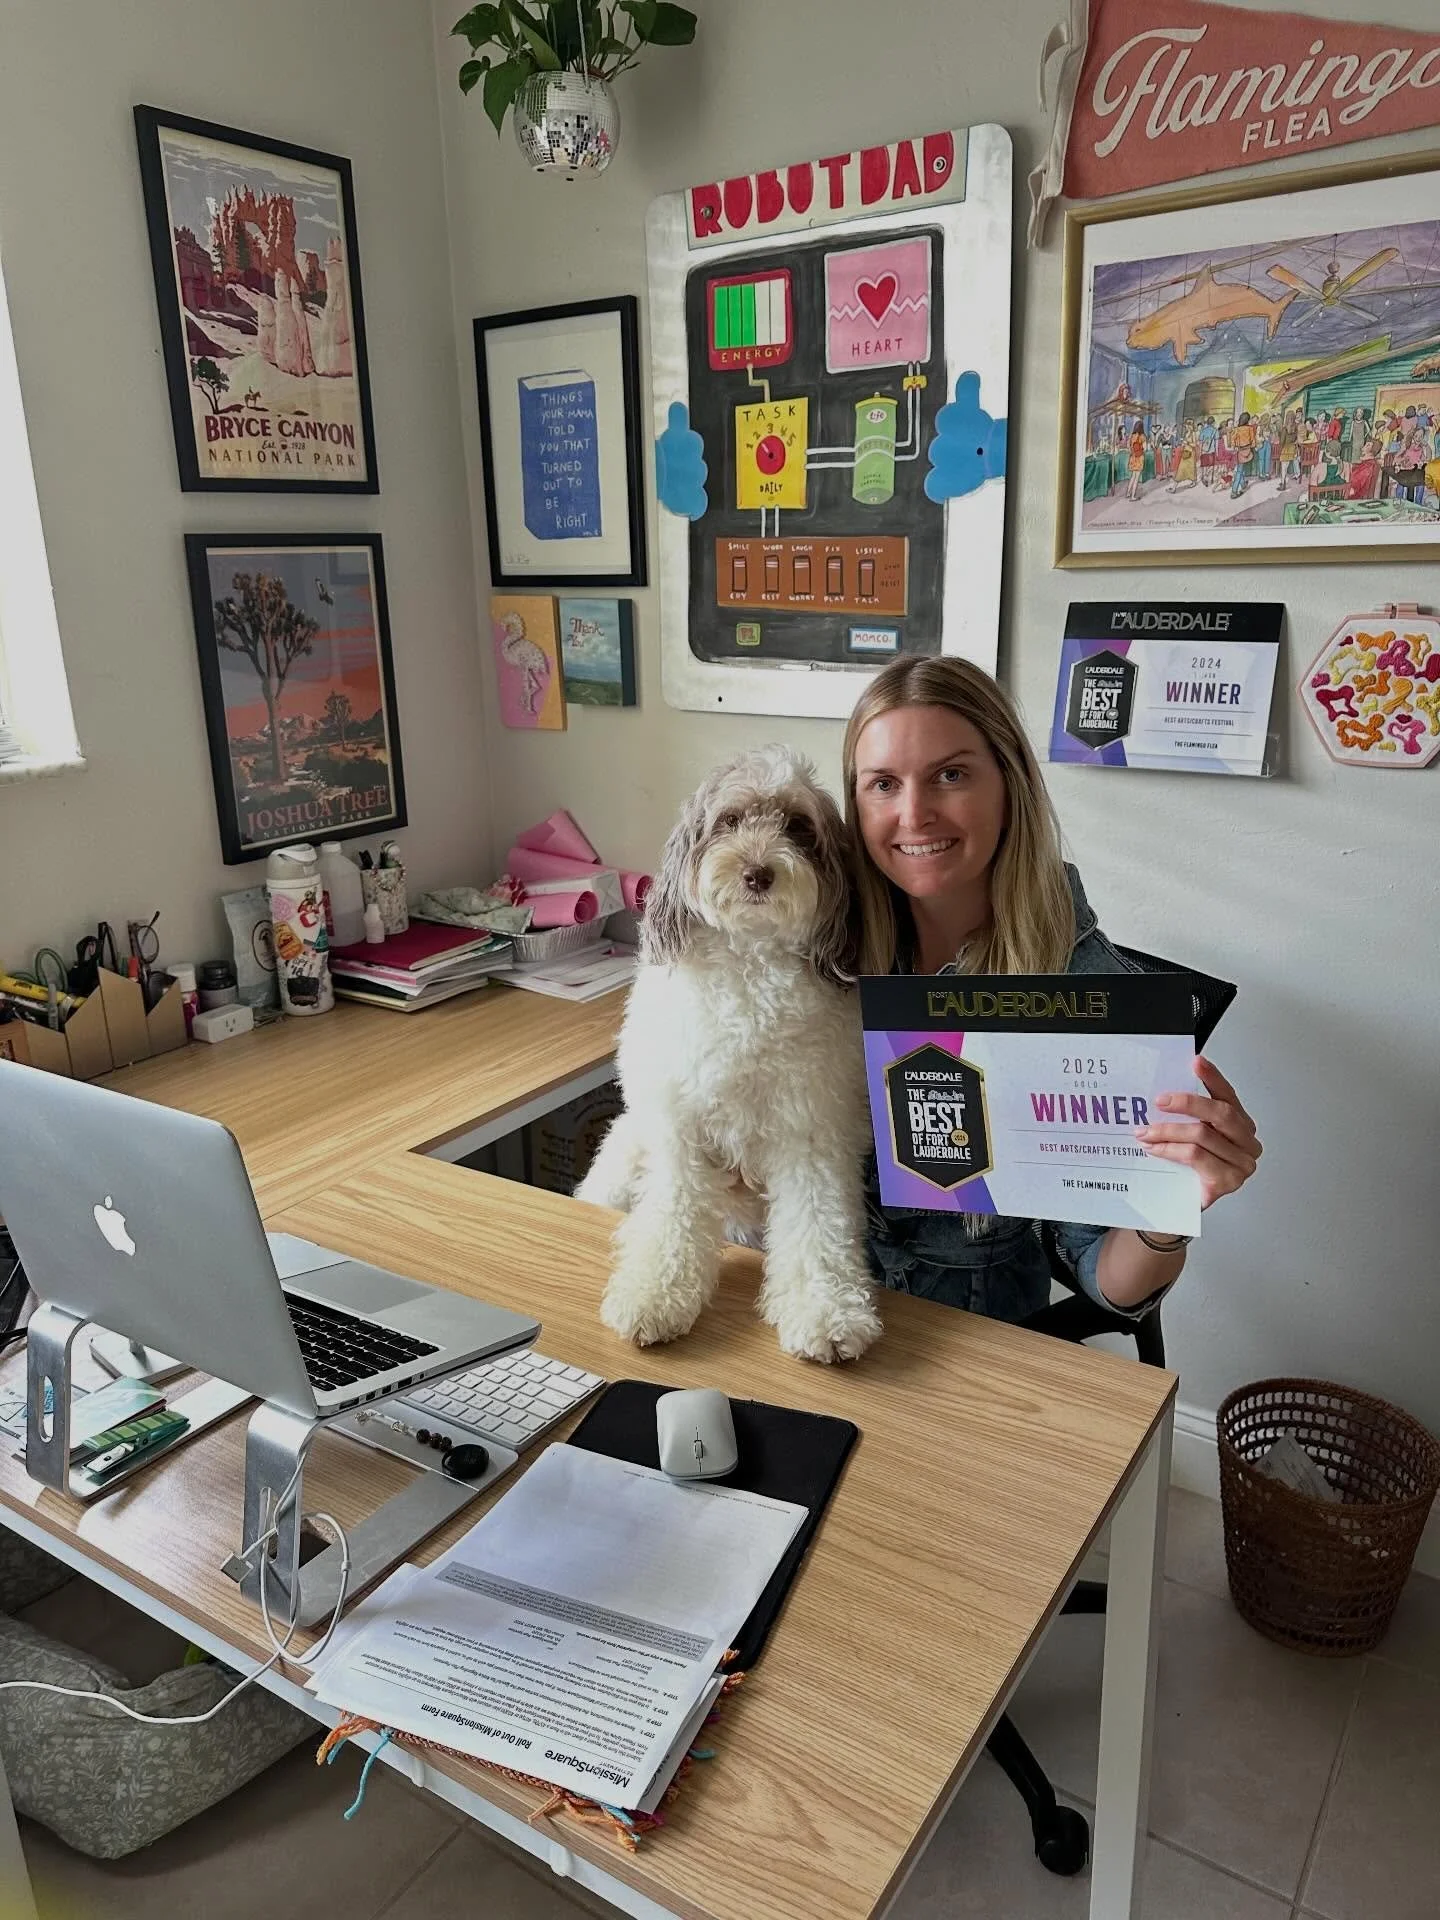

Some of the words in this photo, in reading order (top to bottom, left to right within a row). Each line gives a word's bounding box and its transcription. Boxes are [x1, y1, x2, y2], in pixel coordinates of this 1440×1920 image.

[1092, 24, 1440, 158] Flamingo
[1242, 108, 1332, 153] FLEA
[851, 337, 904, 357] HEART
[721, 347, 782, 363] ENERGY
[541, 391, 583, 406] THINGS
[567, 409, 594, 420] MAMA
[742, 404, 796, 422] TASK
[205, 415, 272, 443] BRYCE
[278, 419, 355, 449] CANYON
[549, 424, 575, 436] TOLD
[767, 423, 774, 434] 3
[780, 426, 788, 437] 4
[787, 432, 797, 447] 5
[564, 438, 591, 451] THAT
[208, 449, 303, 465] NATIONAL
[314, 453, 356, 467] PARK
[542, 460, 582, 474] TURNED
[543, 477, 562, 491] OUT
[567, 476, 582, 488] TO
[759, 481, 784, 495] DAILY
[545, 496, 559, 510] BE
[555, 513, 587, 530] RIGHT
[728, 542, 750, 551] SMILE
[855, 547, 884, 555] LISTEN
[823, 595, 845, 603] PLAY
[569, 616, 605, 637] Thank
[1110, 612, 1229, 631] LAUDERDALE
[1084, 666, 1125, 675] LAUDERDALE
[1191, 657, 1221, 669] 2024
[1083, 678, 1097, 688] THE
[1080, 687, 1122, 711] BEST
[1166, 681, 1241, 705] WINNER
[1079, 710, 1089, 719] OF
[1089, 710, 1106, 720] FORT
[1164, 716, 1177, 724] BEST
[1177, 717, 1211, 726] ARTS/CRAFTS
[1078, 719, 1119, 730] LAUDERDALE
[1174, 740, 1183, 748] THE
[1183, 741, 1207, 749] FLAMINGO
[246, 800, 332, 839] JOSHUA
[334, 787, 389, 814] TREE
[263, 818, 333, 840] NATIONAL
[341, 811, 371, 825] PARK
[926, 990, 1105, 1018] LAUDERDALE
[1062, 1058, 1108, 1075] 2025
[904, 1071, 963, 1082] LAUDERDALE
[906, 1088, 927, 1101] THE
[1030, 1092, 1150, 1126] WINNER
[907, 1101, 966, 1134] BEST
[911, 1132, 924, 1145] OF
[925, 1133, 950, 1147] FORT
[912, 1144, 972, 1160] LAUDERDALE
[1039, 1143, 1058, 1153] BEST
[1060, 1144, 1111, 1156] ARTS/CRAFTS
[1062, 1178, 1075, 1188] THE
[1076, 1180, 1111, 1191] FLAMINGO
[1112, 1182, 1129, 1192] FLEA
[420, 1702, 440, 1719] Form
[439, 1710, 494, 1739] MissionSquare
[491, 1727, 502, 1740] of
[502, 1731, 516, 1745] Out
[515, 1737, 533, 1750] Roll
[544, 1749, 631, 1789] MissionSquare
